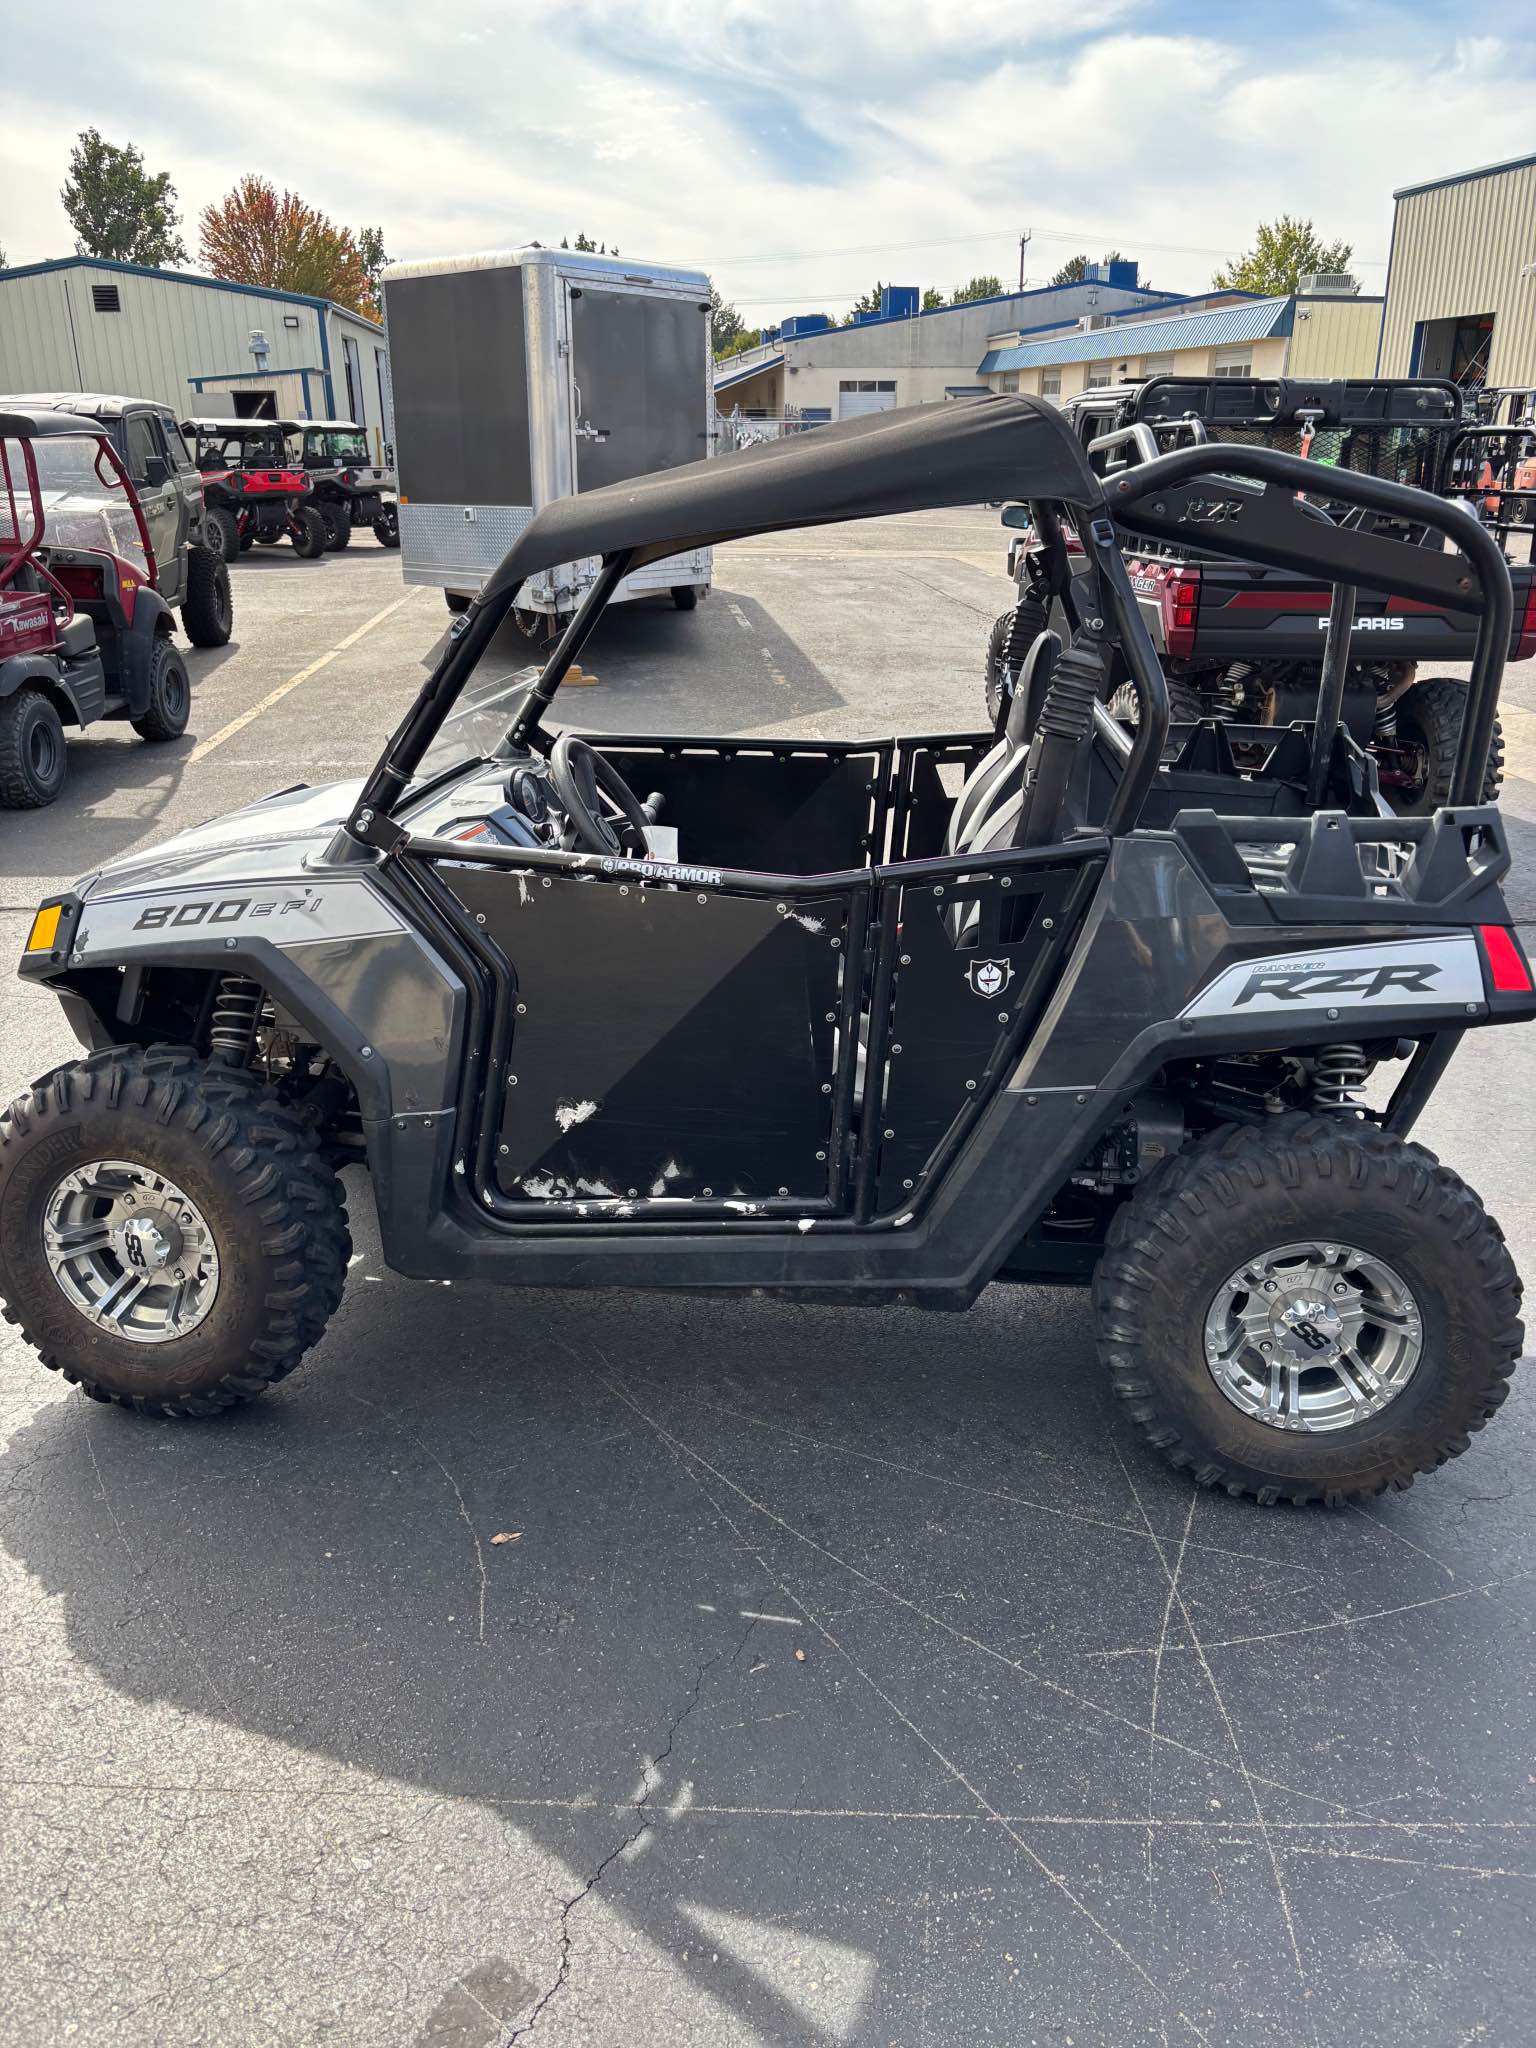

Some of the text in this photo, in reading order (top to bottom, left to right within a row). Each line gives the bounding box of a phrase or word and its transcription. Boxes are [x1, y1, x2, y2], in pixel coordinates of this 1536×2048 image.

[1178, 497, 1244, 523] RZR
[4, 611, 49, 632] Kawasaki
[1318, 617, 1404, 630] PARIS
[618, 861, 721, 884] PRO ARMOR
[132, 898, 252, 930] 800
[1251, 962, 1326, 974] RANGER
[1232, 963, 1443, 1008] RZR
[125, 1231, 147, 1268] SS
[1290, 1321, 1331, 1351] SS
